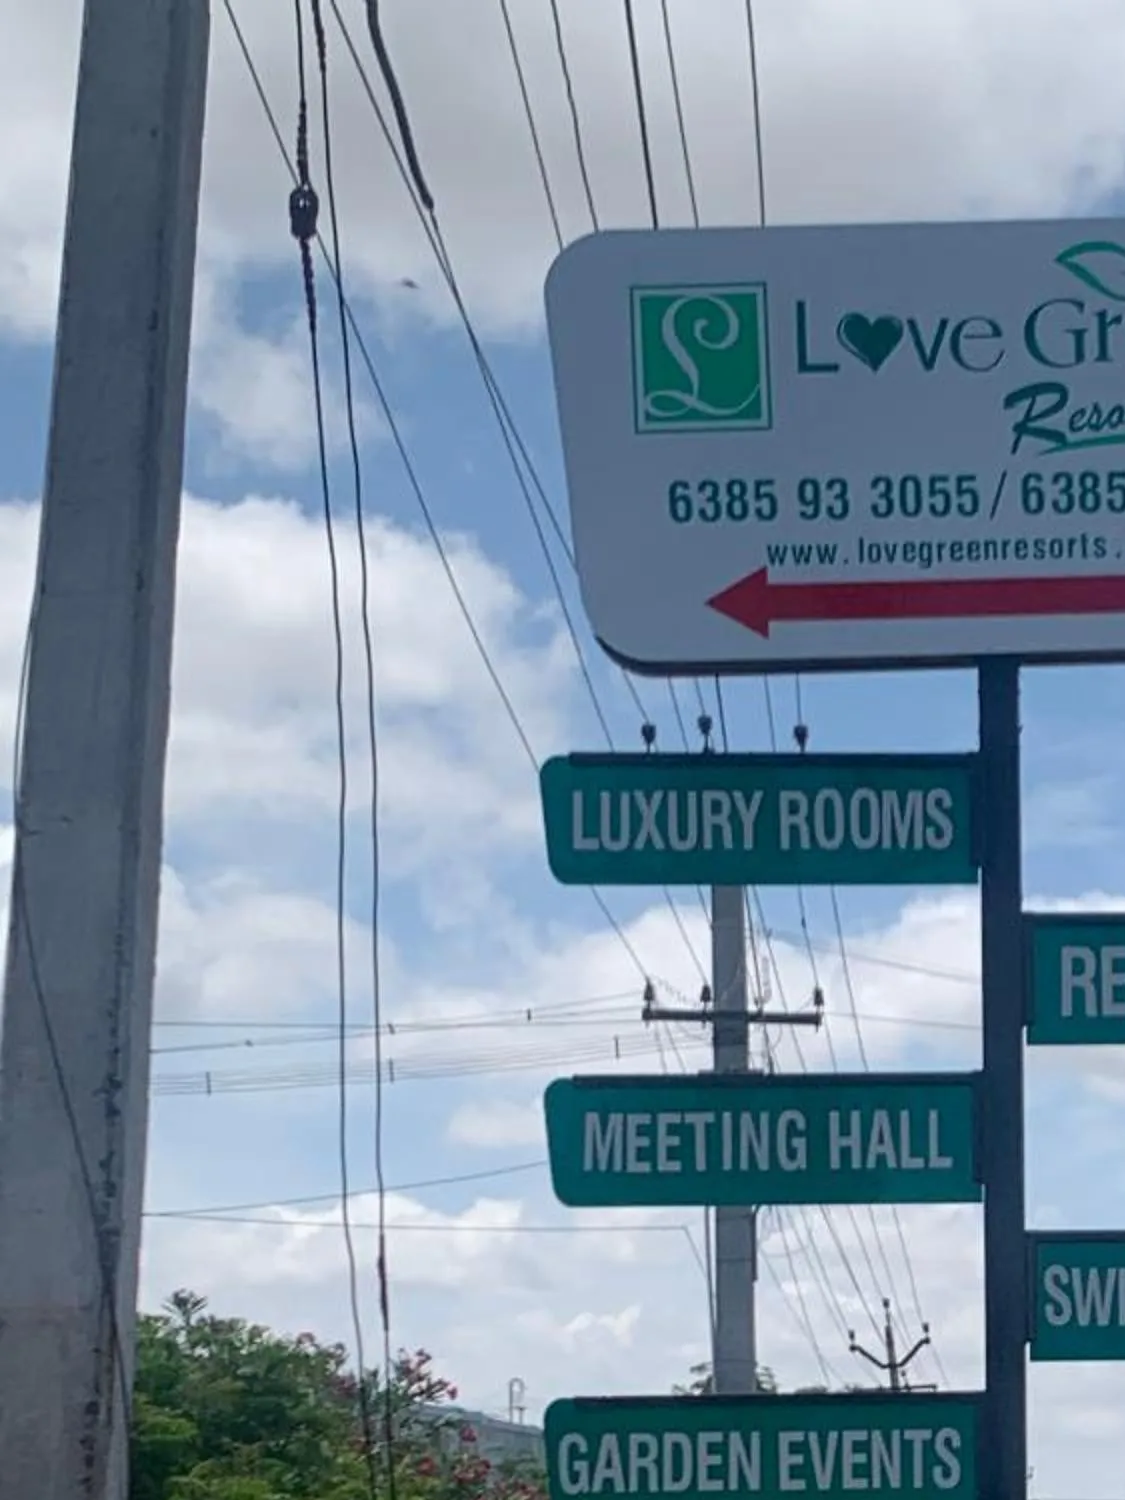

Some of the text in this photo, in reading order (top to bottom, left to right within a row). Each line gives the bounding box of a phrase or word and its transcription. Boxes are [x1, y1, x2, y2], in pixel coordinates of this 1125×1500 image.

[668, 479, 777, 523] 6385
[799, 478, 850, 520] 93
[870, 474, 980, 518] 3055
[571, 788, 954, 851] LUXURY ROOMS
[582, 1109, 953, 1174] MEETING HALL
[557, 1427, 961, 1496] GARDEN EVENTS
